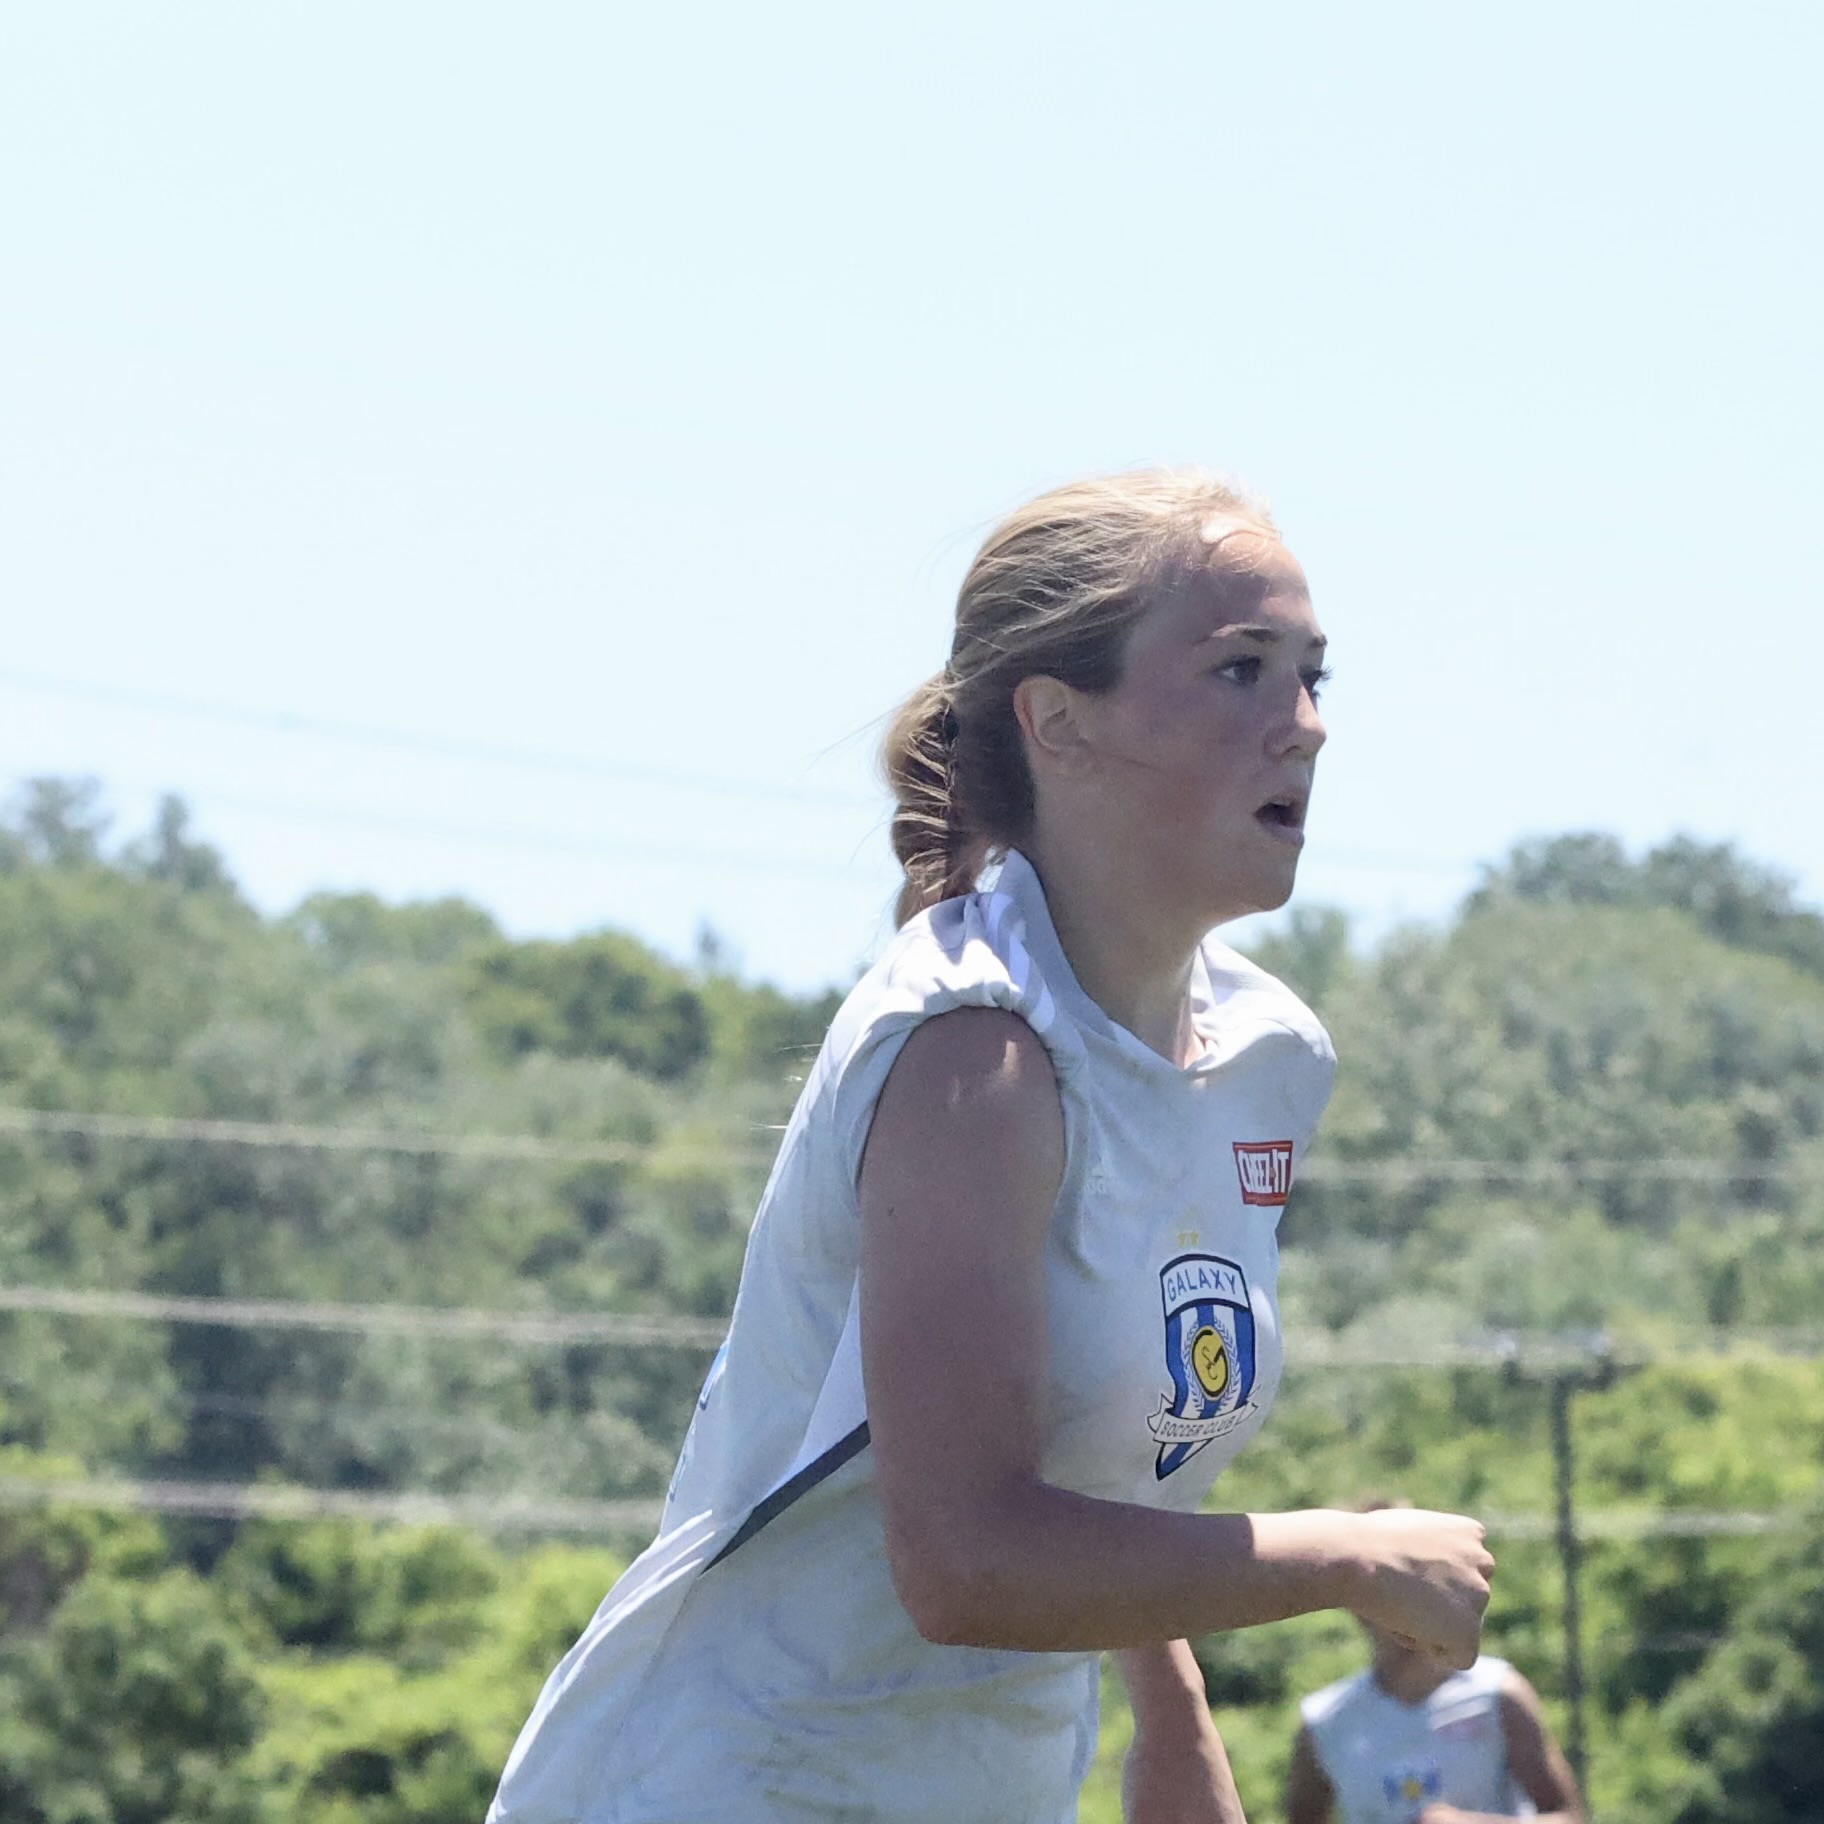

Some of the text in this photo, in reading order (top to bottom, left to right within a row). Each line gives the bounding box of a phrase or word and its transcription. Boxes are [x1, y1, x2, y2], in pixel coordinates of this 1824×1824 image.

[1167, 1267, 1236, 1302] GALAXY
[1160, 1414, 1237, 1438] SOCCER CLUB
